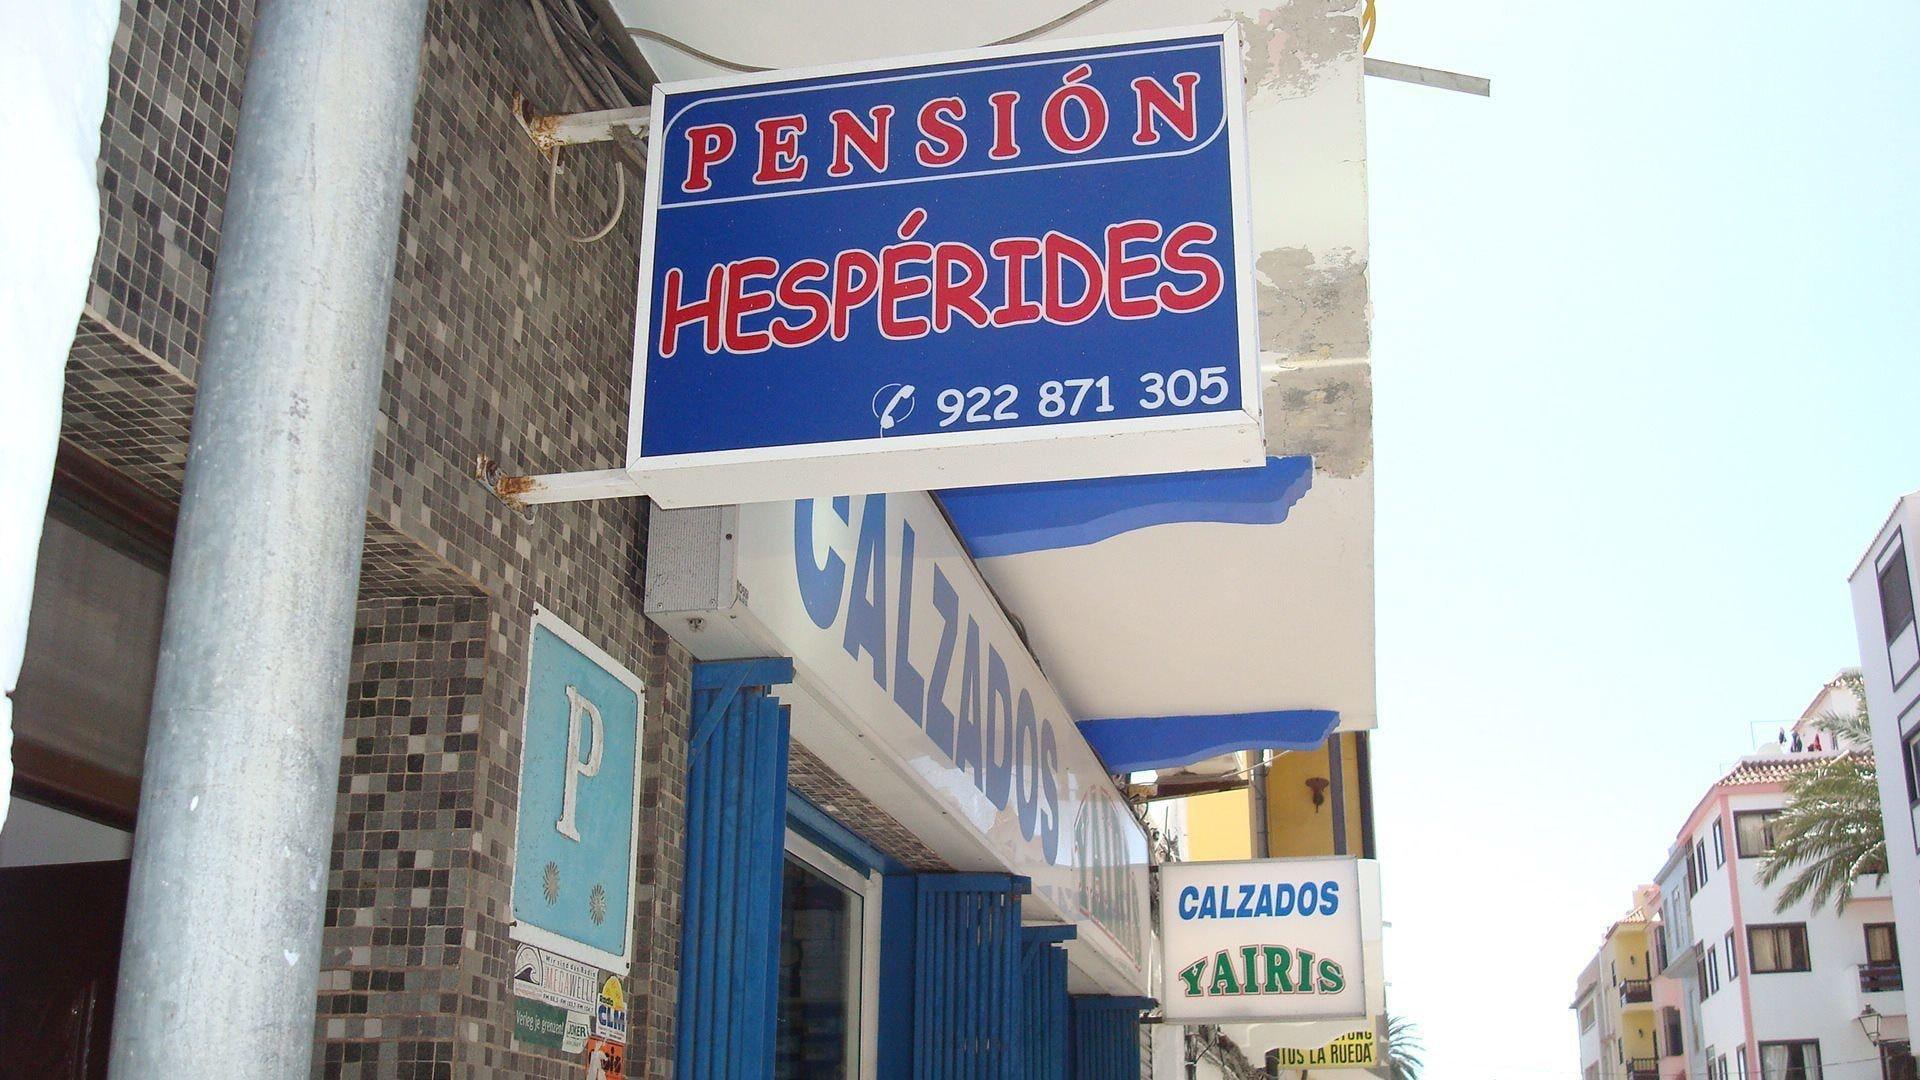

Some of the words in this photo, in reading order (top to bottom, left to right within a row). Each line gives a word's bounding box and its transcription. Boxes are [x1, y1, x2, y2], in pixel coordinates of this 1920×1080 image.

[682, 64, 1201, 193] PENSIÓN
[659, 207, 1224, 358] HESPÉRIDES
[936, 383, 1019, 428] 922
[1038, 375, 1113, 419] 871
[1138, 366, 1229, 411] 305
[794, 492, 1059, 867] CALZADOS
[555, 684, 604, 844] P
[1178, 880, 1340, 920] CALZADOS
[598, 1004, 625, 1032] CLM
[1178, 944, 1346, 997] YAIRIS
